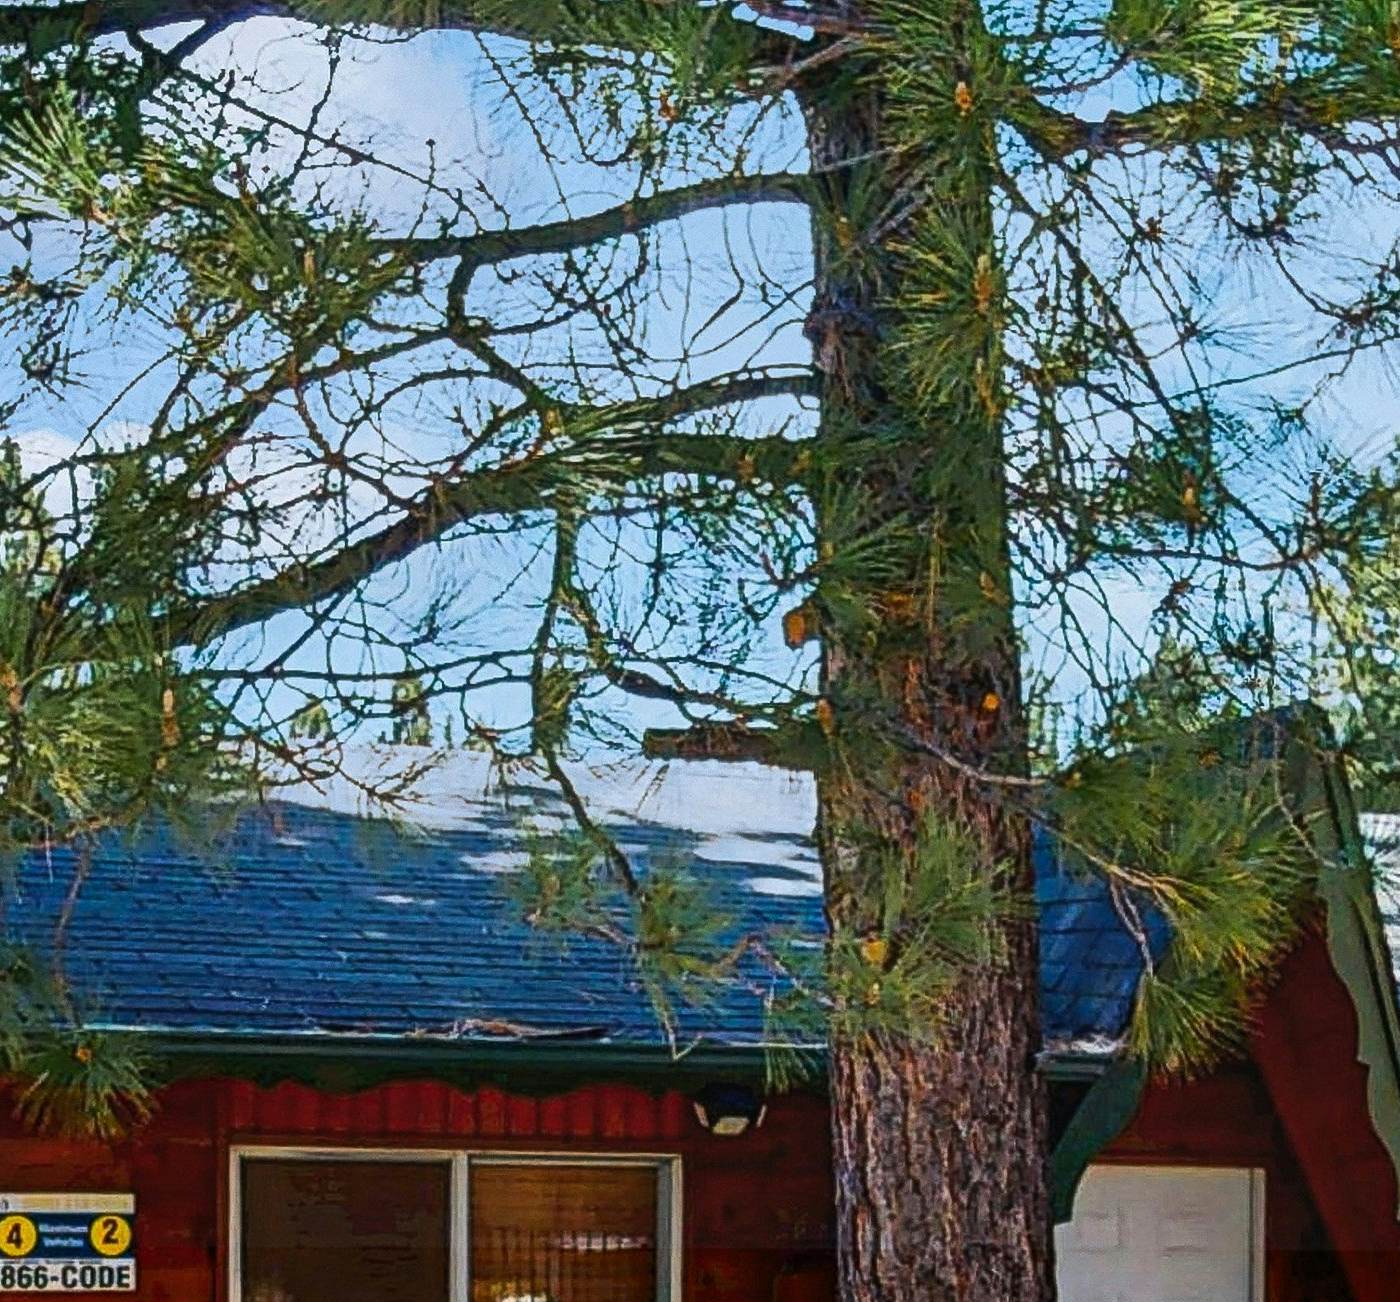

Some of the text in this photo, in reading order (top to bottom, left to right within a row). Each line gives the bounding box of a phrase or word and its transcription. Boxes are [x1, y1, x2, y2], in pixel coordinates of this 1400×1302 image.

[6, 1222, 23, 1249] 4
[101, 1218, 120, 1245] 2
[0, 1265, 131, 1289] 866-CODE
